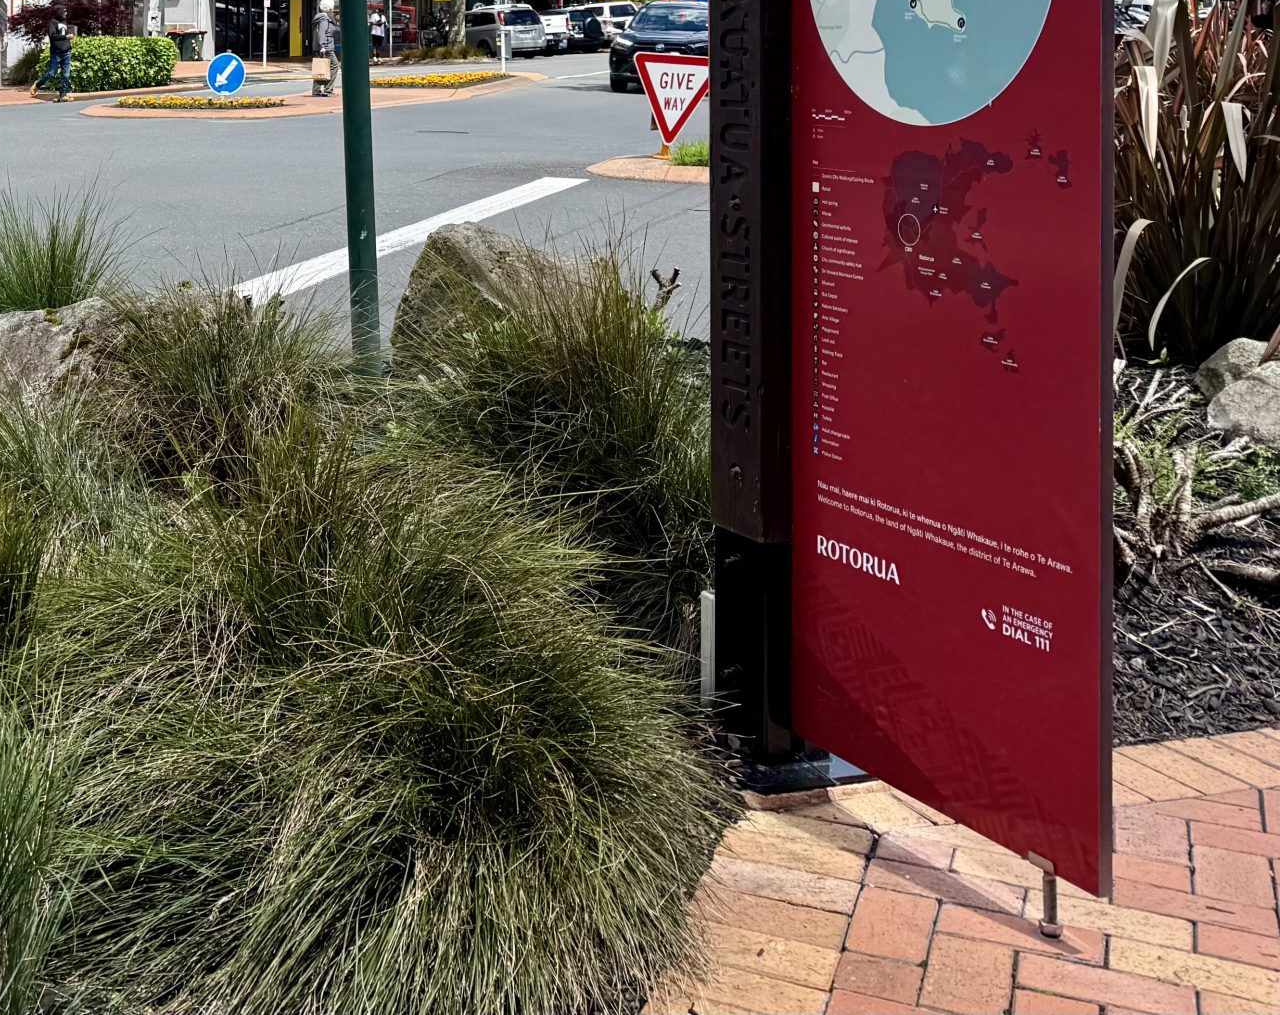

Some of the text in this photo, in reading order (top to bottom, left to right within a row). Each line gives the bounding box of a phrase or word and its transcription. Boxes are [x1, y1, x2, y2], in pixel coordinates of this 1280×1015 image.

[660, 72, 695, 90] GIVE
[664, 97, 686, 111] WAY
[817, 479, 829, 491] Nau
[829, 484, 841, 495] mai,
[841, 488, 858, 501] haere
[858, 494, 870, 505] mai
[870, 497, 877, 506] ki
[876, 499, 902, 517] Rotorua,
[902, 508, 909, 517] ki
[909, 511, 916, 520] te
[916, 514, 941, 529] whenua
[966, 529, 1000, 550] Whakaue,
[1004, 543, 1012, 553] te
[1012, 547, 1029, 559] rohe
[1030, 553, 1035, 561] o
[1037, 553, 1046, 564] Te
[1047, 557, 1073, 574] Arawa.
[817, 494, 842, 510] Welcome
[843, 503, 850, 512] to
[850, 505, 875, 522] Rotorua,
[875, 514, 885, 524] the
[885, 517, 899, 529] land
[899, 523, 906, 532] of
[925, 531, 956, 550] Whakaue,
[956, 543, 968, 554] the
[968, 545, 993, 563] district
[993, 555, 1001, 565] of
[1001, 557, 1011, 569] Te
[1011, 562, 1037, 578] Arawa.
[816, 534, 901, 586] ROTORUA
[1002, 604, 1053, 630] IN THE CASE OF
[1002, 614, 1054, 640] AN EMERGENCY
[1002, 623, 1050, 653] DIAL 111
